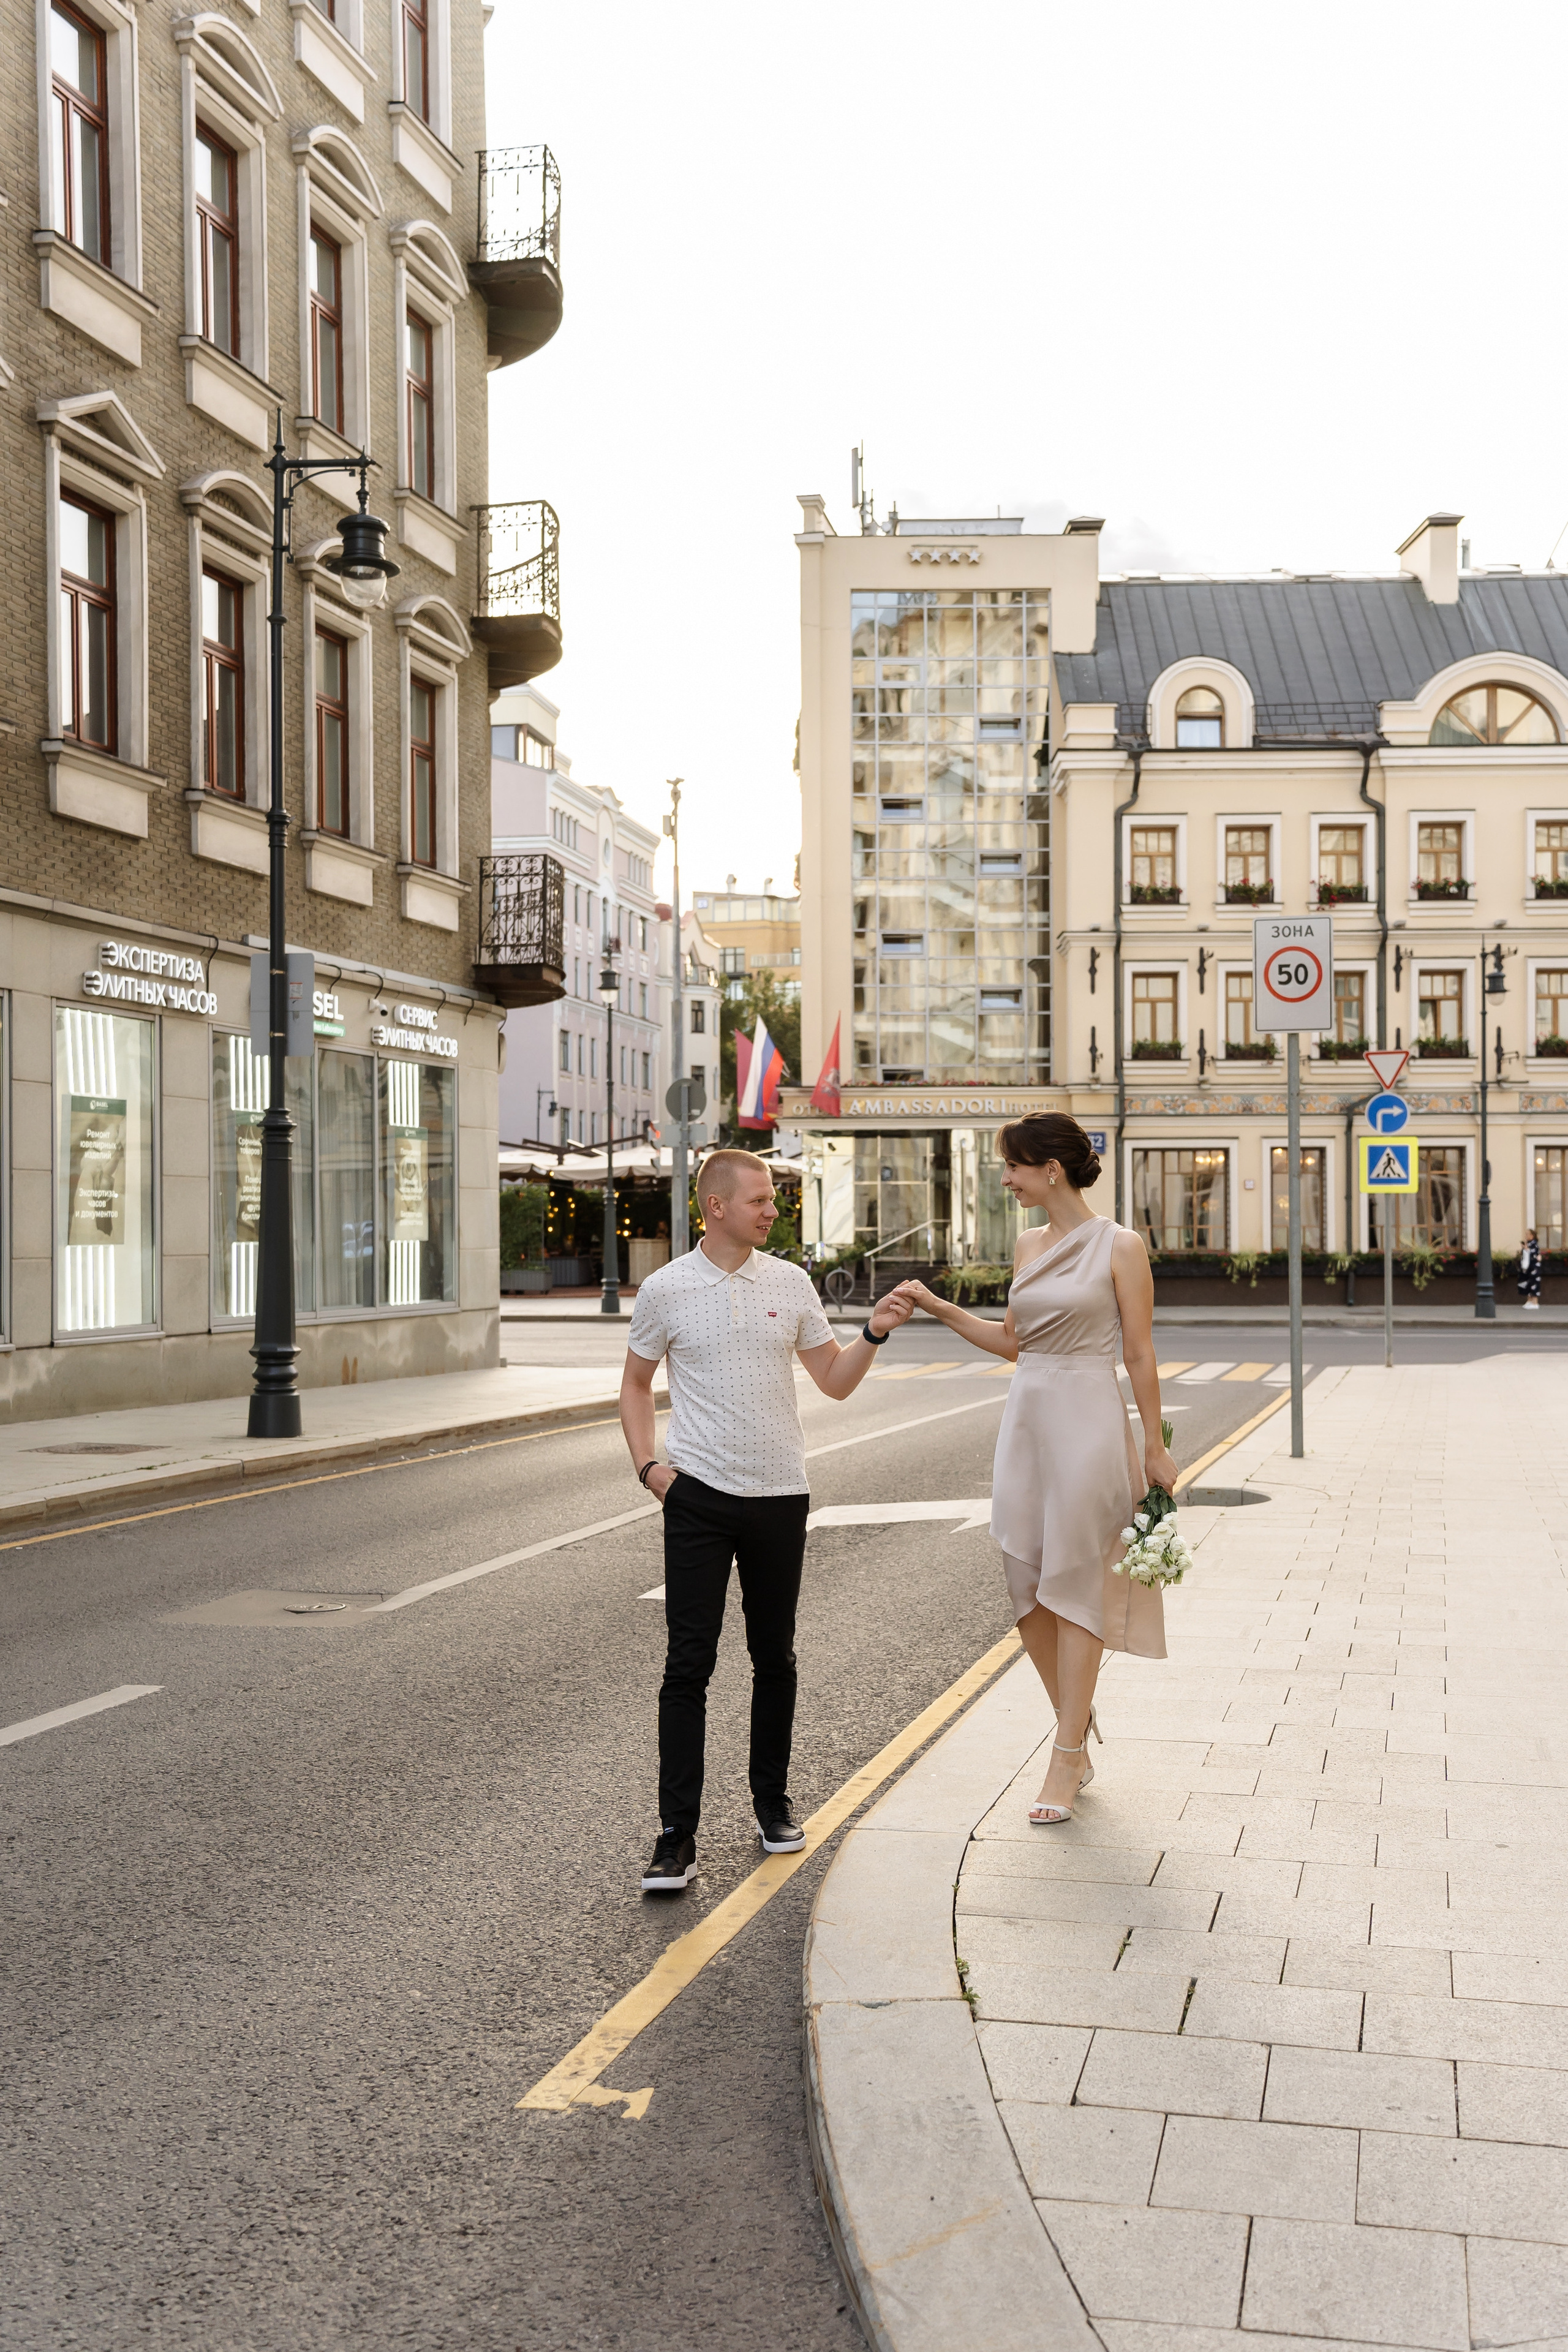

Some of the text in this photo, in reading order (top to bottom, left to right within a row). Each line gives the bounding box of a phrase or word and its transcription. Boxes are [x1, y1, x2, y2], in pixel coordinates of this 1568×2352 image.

[1271, 925, 1314, 938] ЗОНА
[102, 941, 205, 984] ЭКСПЕРТИЗА
[1278, 963, 1308, 986] 50
[87, 970, 218, 1016] ЭЛИТНЫХ ЧАСОВ
[398, 1004, 439, 1031] СЕРВИС
[376, 1025, 459, 1058] ЭЛИТНЫХ ЧАСОВ
[849, 1098, 1006, 1115] AMBASSADORI
[87, 1128, 111, 1139] Ремонт
[80, 1140, 116, 1151] ювелирных
[85, 1150, 111, 1159] изделий
[79, 1188, 116, 1199] Экспертиза
[80, 1210, 118, 1220] документов
